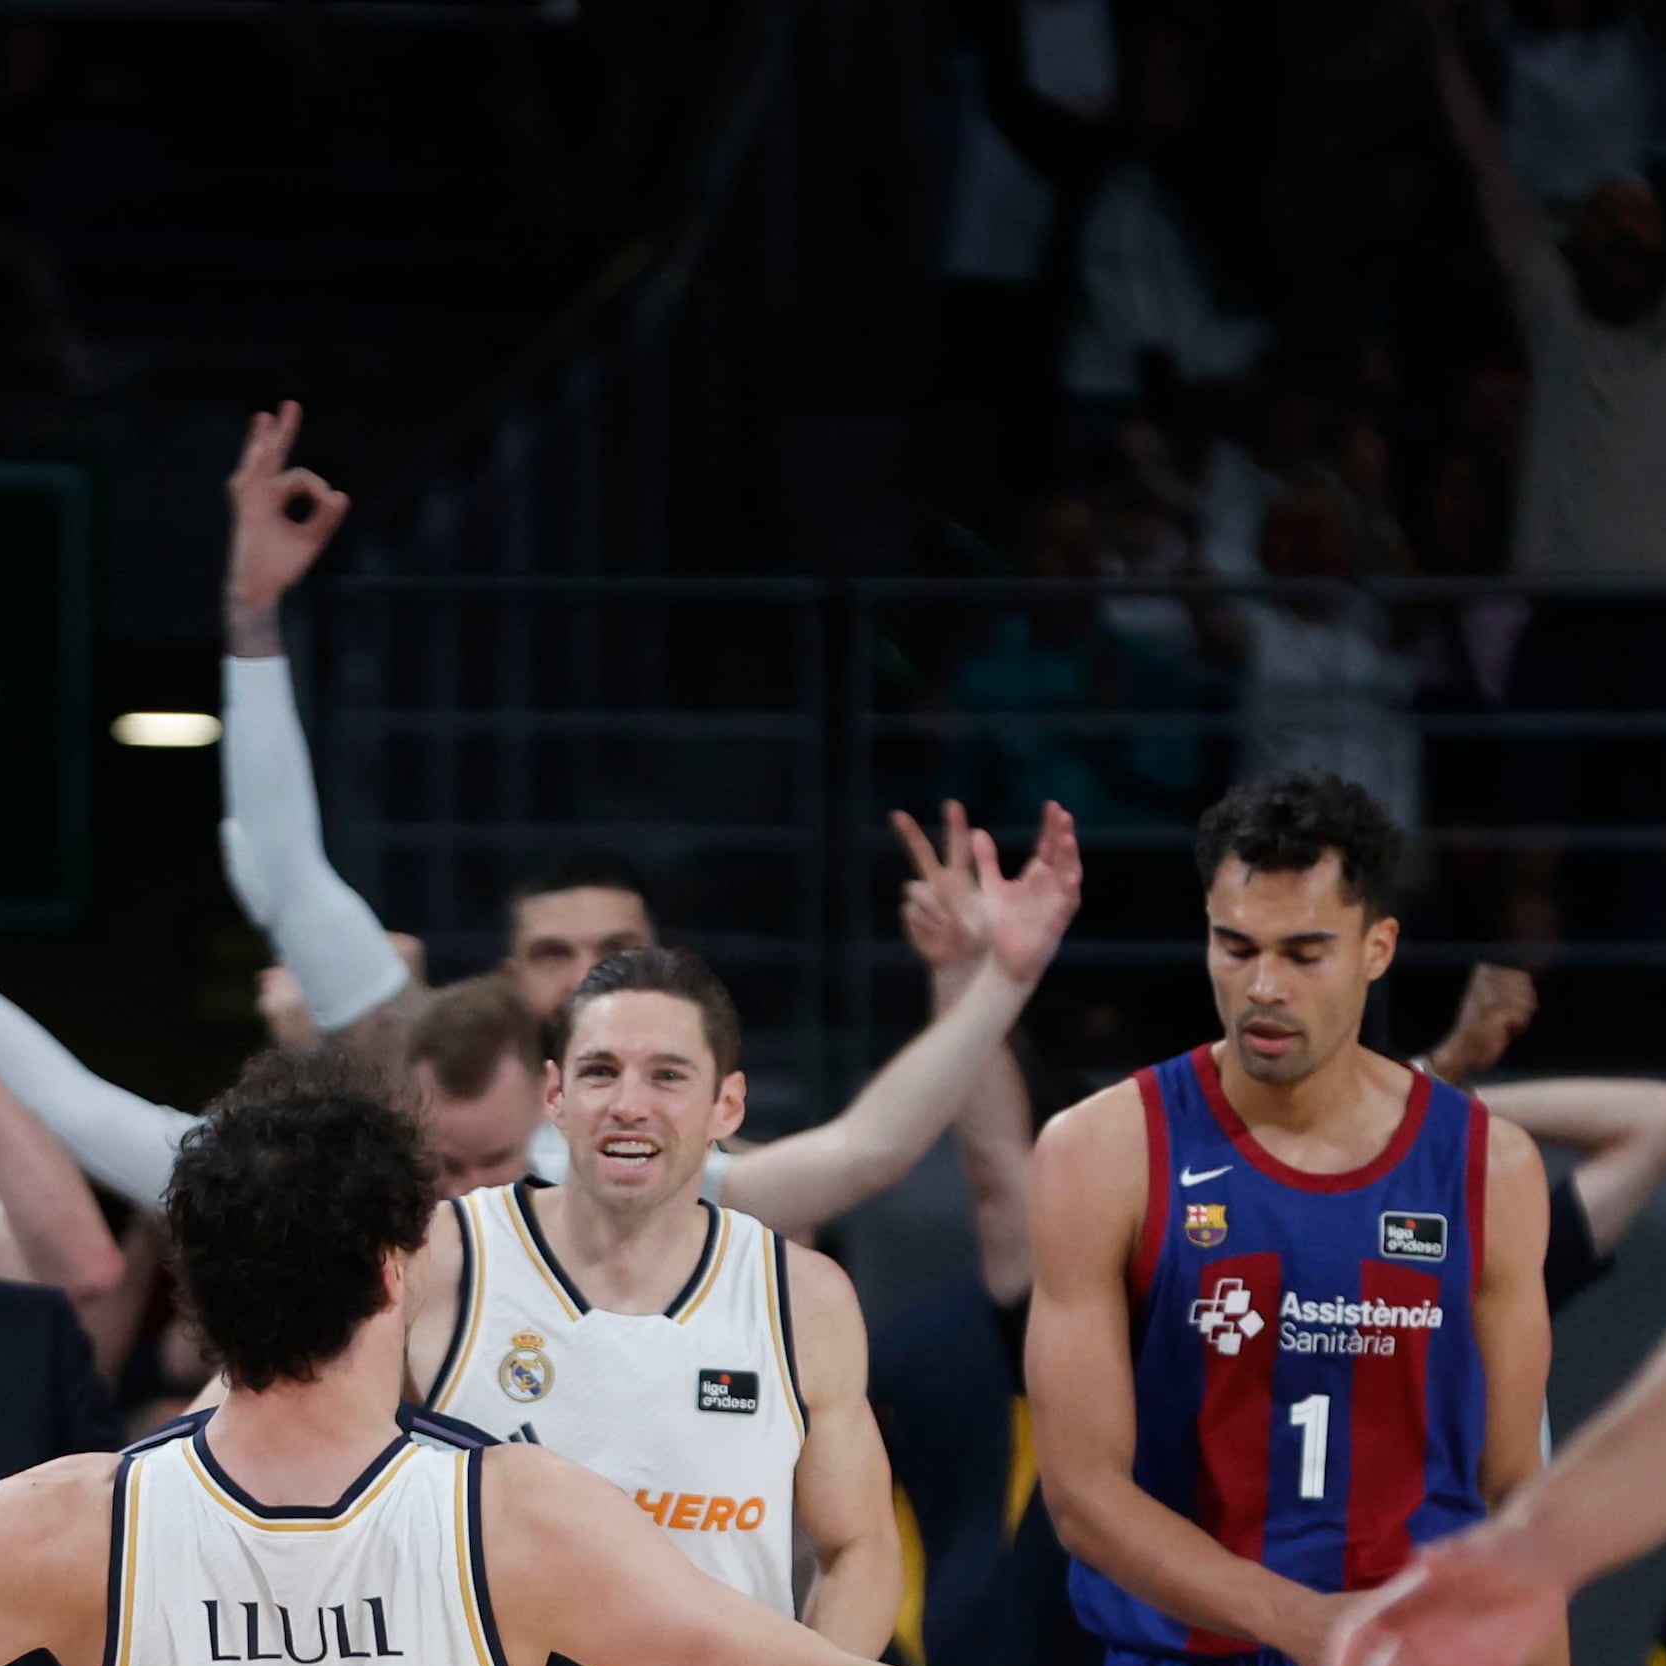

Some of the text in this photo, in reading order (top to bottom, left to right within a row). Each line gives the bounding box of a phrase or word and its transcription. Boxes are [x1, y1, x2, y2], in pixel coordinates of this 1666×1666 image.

[1280, 1290, 1444, 1329] Assistència
[1280, 1321, 1396, 1356] Sanitària
[702, 1380, 729, 1396] liga
[702, 1395, 757, 1410] endesa
[1289, 1392, 1332, 1500] 1
[202, 1597, 403, 1664] LLULL
